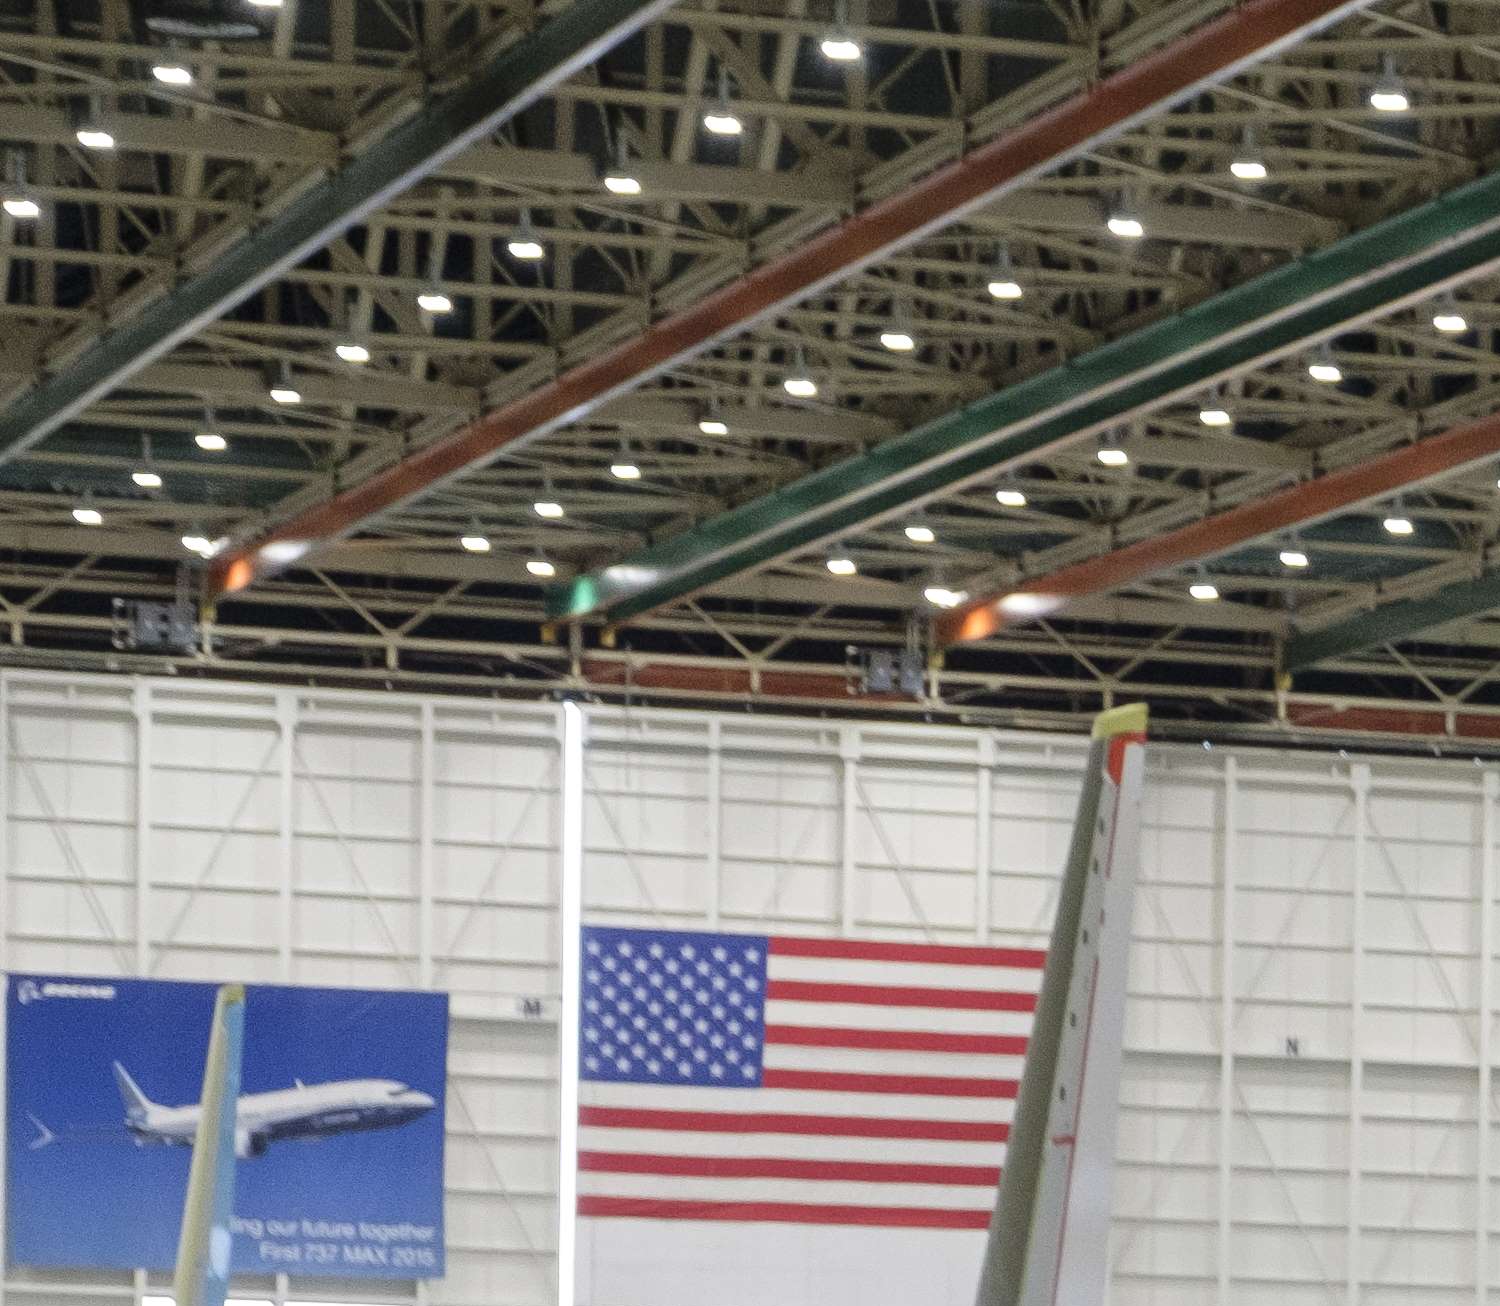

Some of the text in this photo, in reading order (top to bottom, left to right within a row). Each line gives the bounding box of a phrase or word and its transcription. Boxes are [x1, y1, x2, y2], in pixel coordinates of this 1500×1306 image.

[1286, 1036, 1298, 1057] N
[266, 1220, 298, 1237] our
[302, 1219, 356, 1238] future
[358, 1222, 435, 1242] together
[259, 1241, 299, 1261] First
[305, 1243, 337, 1262] 737
[343, 1245, 386, 1265] MAX
